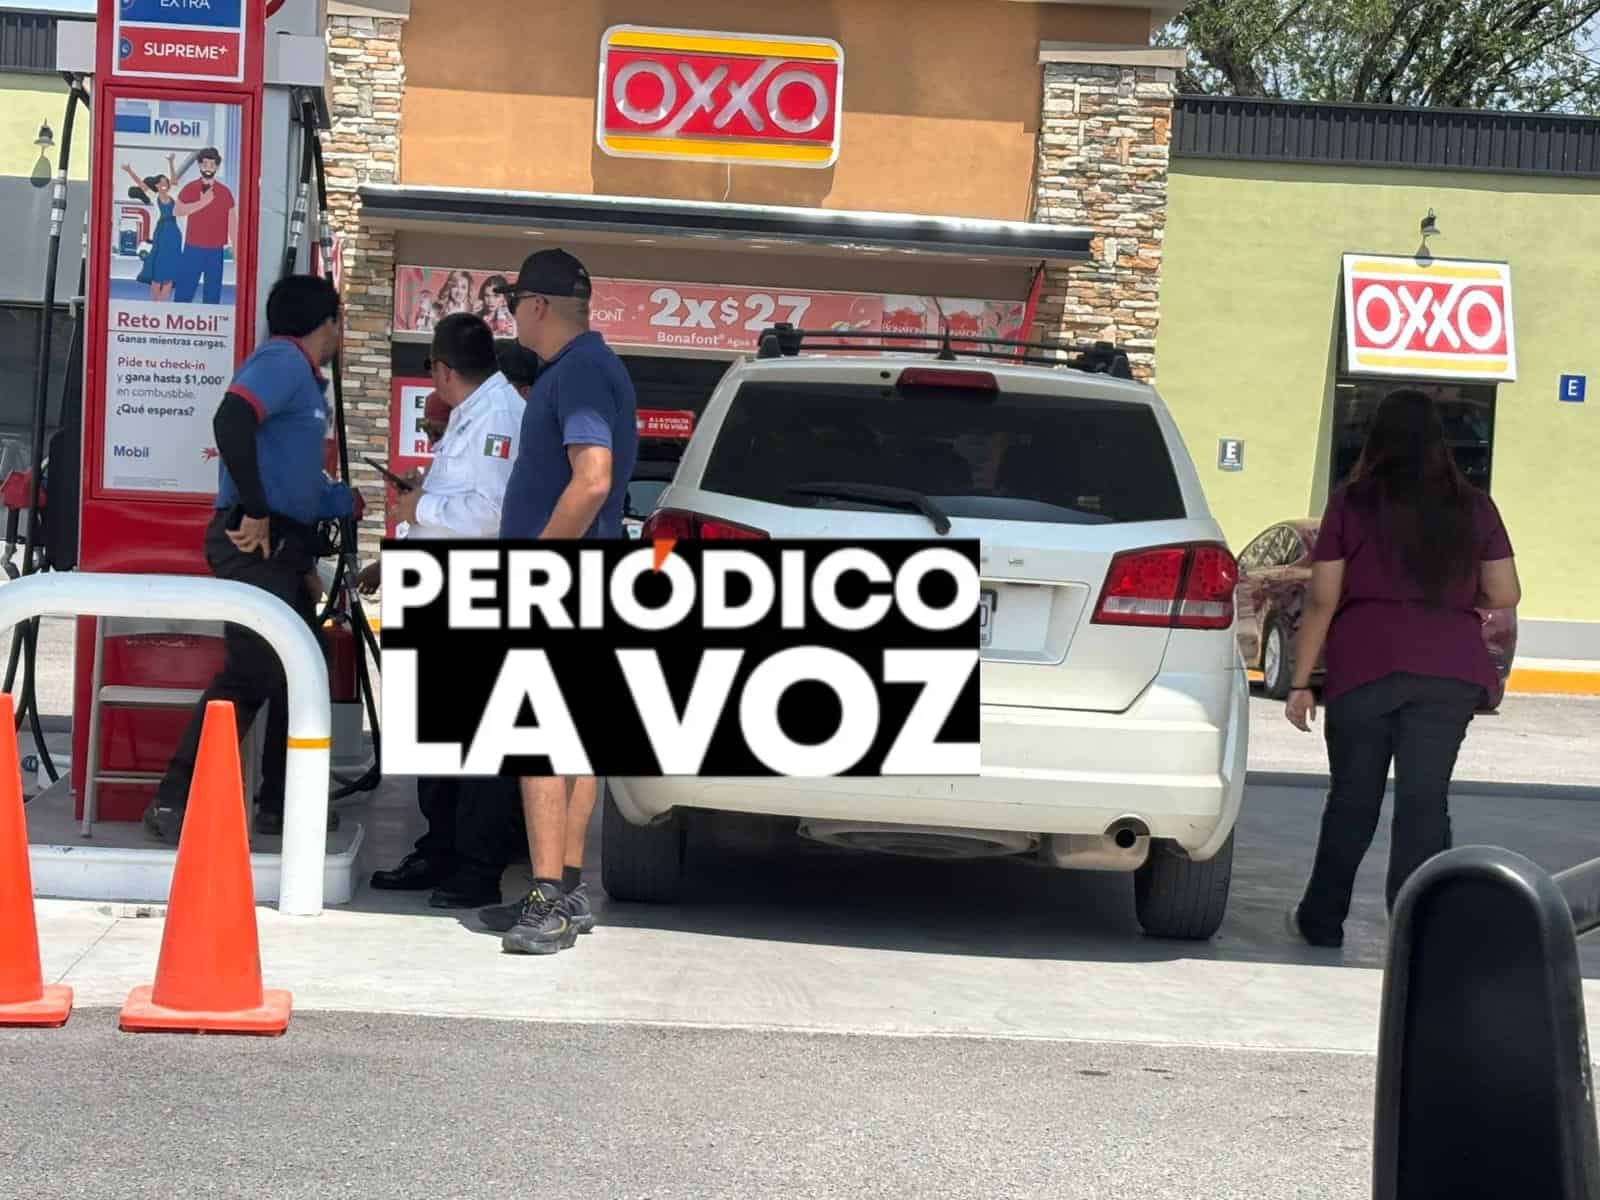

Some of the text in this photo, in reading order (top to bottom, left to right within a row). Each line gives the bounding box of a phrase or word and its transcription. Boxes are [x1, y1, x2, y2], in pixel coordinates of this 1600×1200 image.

[160, 0, 210, 9] EXTRA
[612, 57, 828, 137] OXXO
[154, 119, 200, 137] Mobil
[117, 311, 160, 329] Reto
[1356, 284, 1502, 351] OXXO
[117, 334, 226, 349] Ganas mientras cargas.
[118, 356, 206, 371] Pide tu check-in
[116, 373, 122, 383] y
[125, 373, 150, 384] gana
[153, 373, 181, 384] hasta
[117, 387, 129, 395] en
[1567, 379, 1578, 396] E
[116, 403, 195, 419] ¿Qué esperas?
[113, 445, 150, 458] Mobil
[1226, 441, 1237, 458] E
